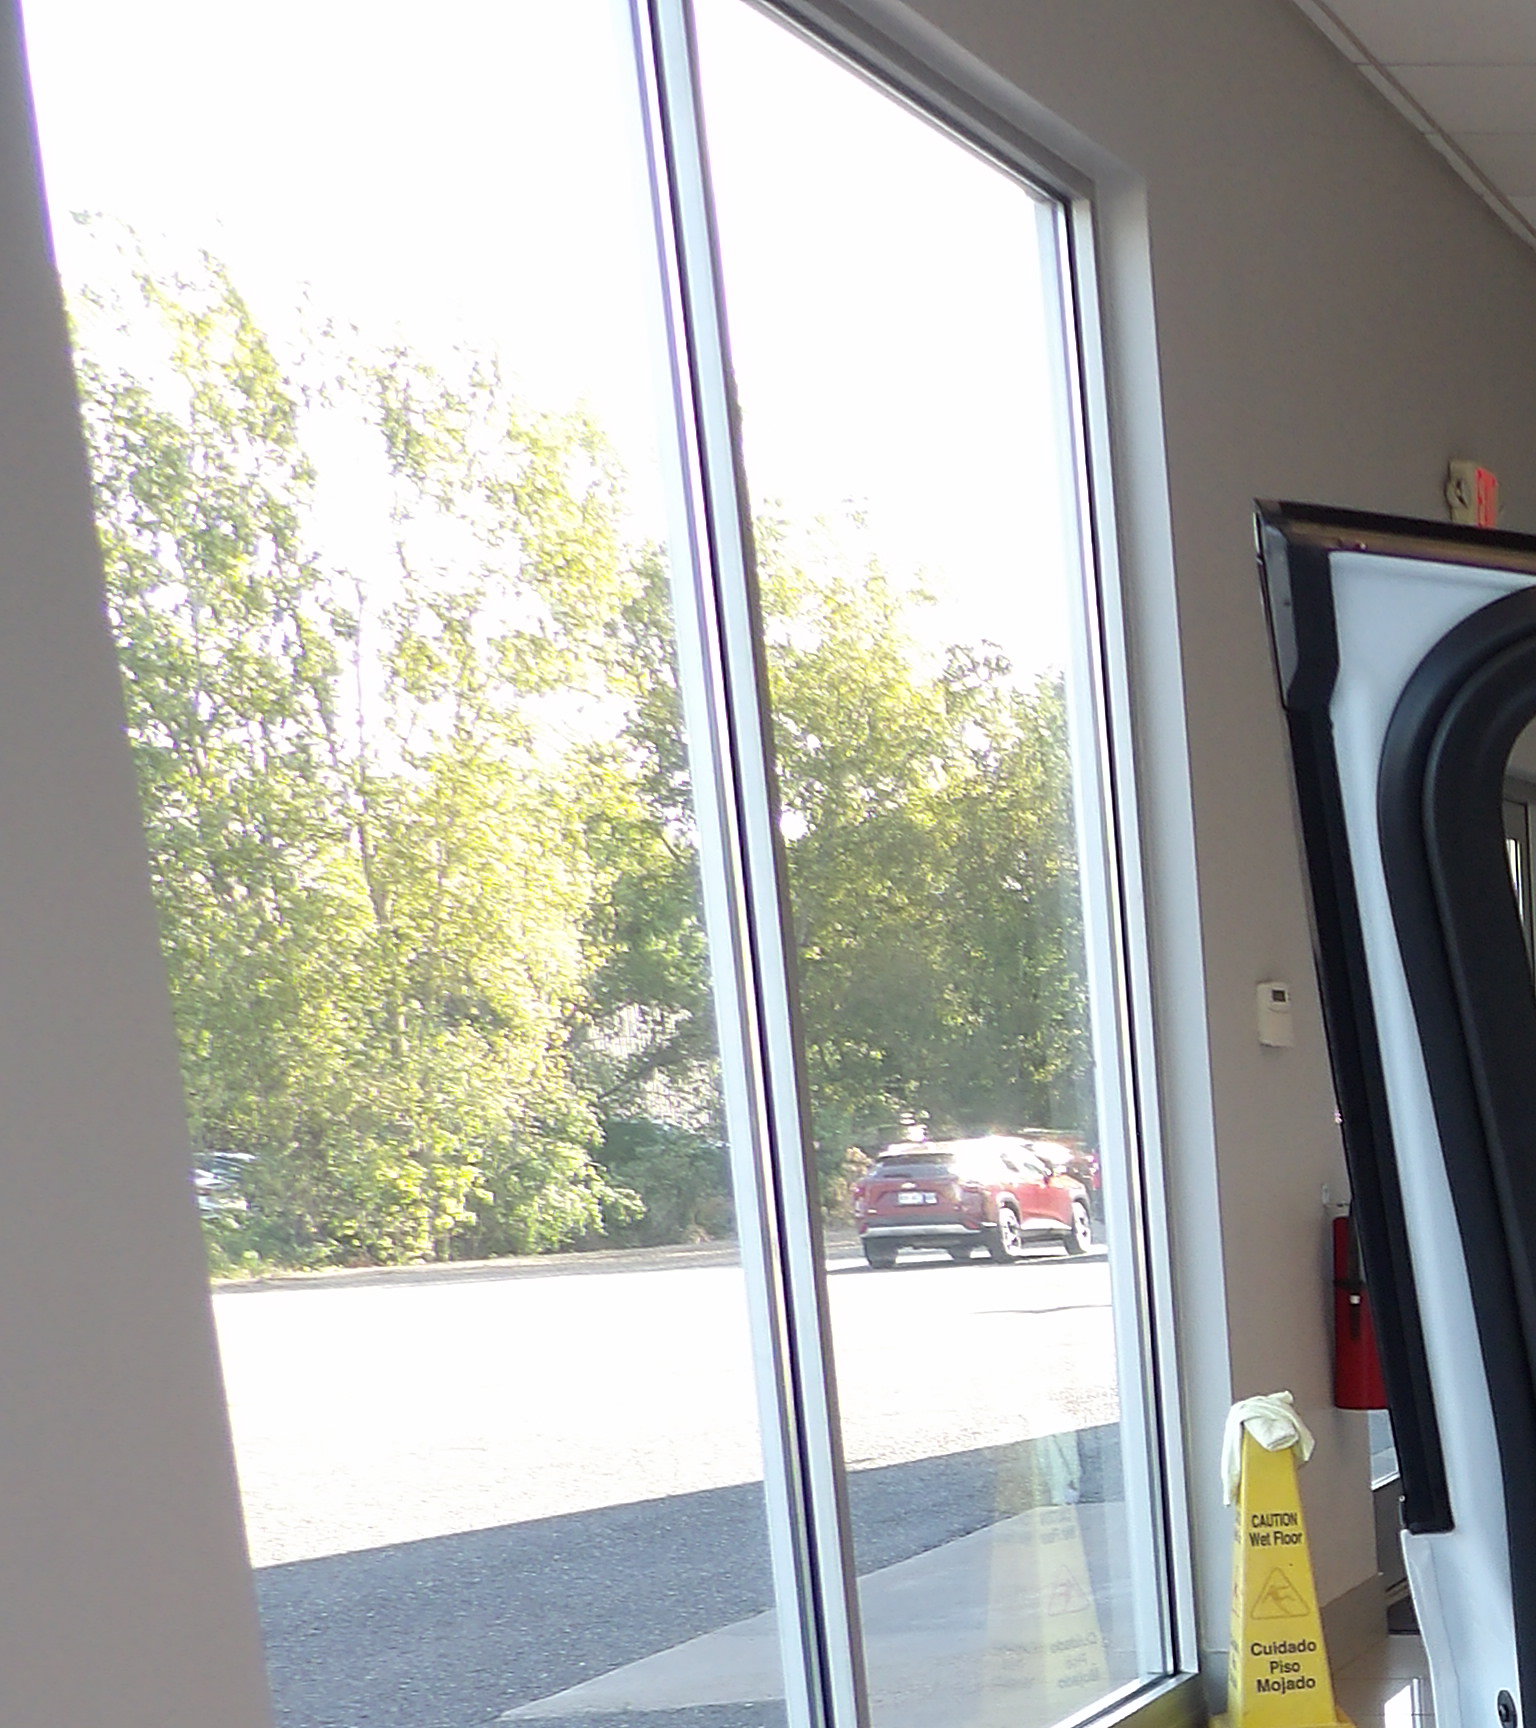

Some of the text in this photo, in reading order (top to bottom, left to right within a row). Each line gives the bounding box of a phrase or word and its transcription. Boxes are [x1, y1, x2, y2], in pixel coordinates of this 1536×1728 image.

[1251, 1512, 1298, 1528] CAUTION
[1249, 1530, 1303, 1547] Wet Floor
[1250, 1639, 1317, 1656] Cuidado
[1269, 1660, 1301, 1674] Piso
[1256, 1675, 1316, 1695] Mojado
